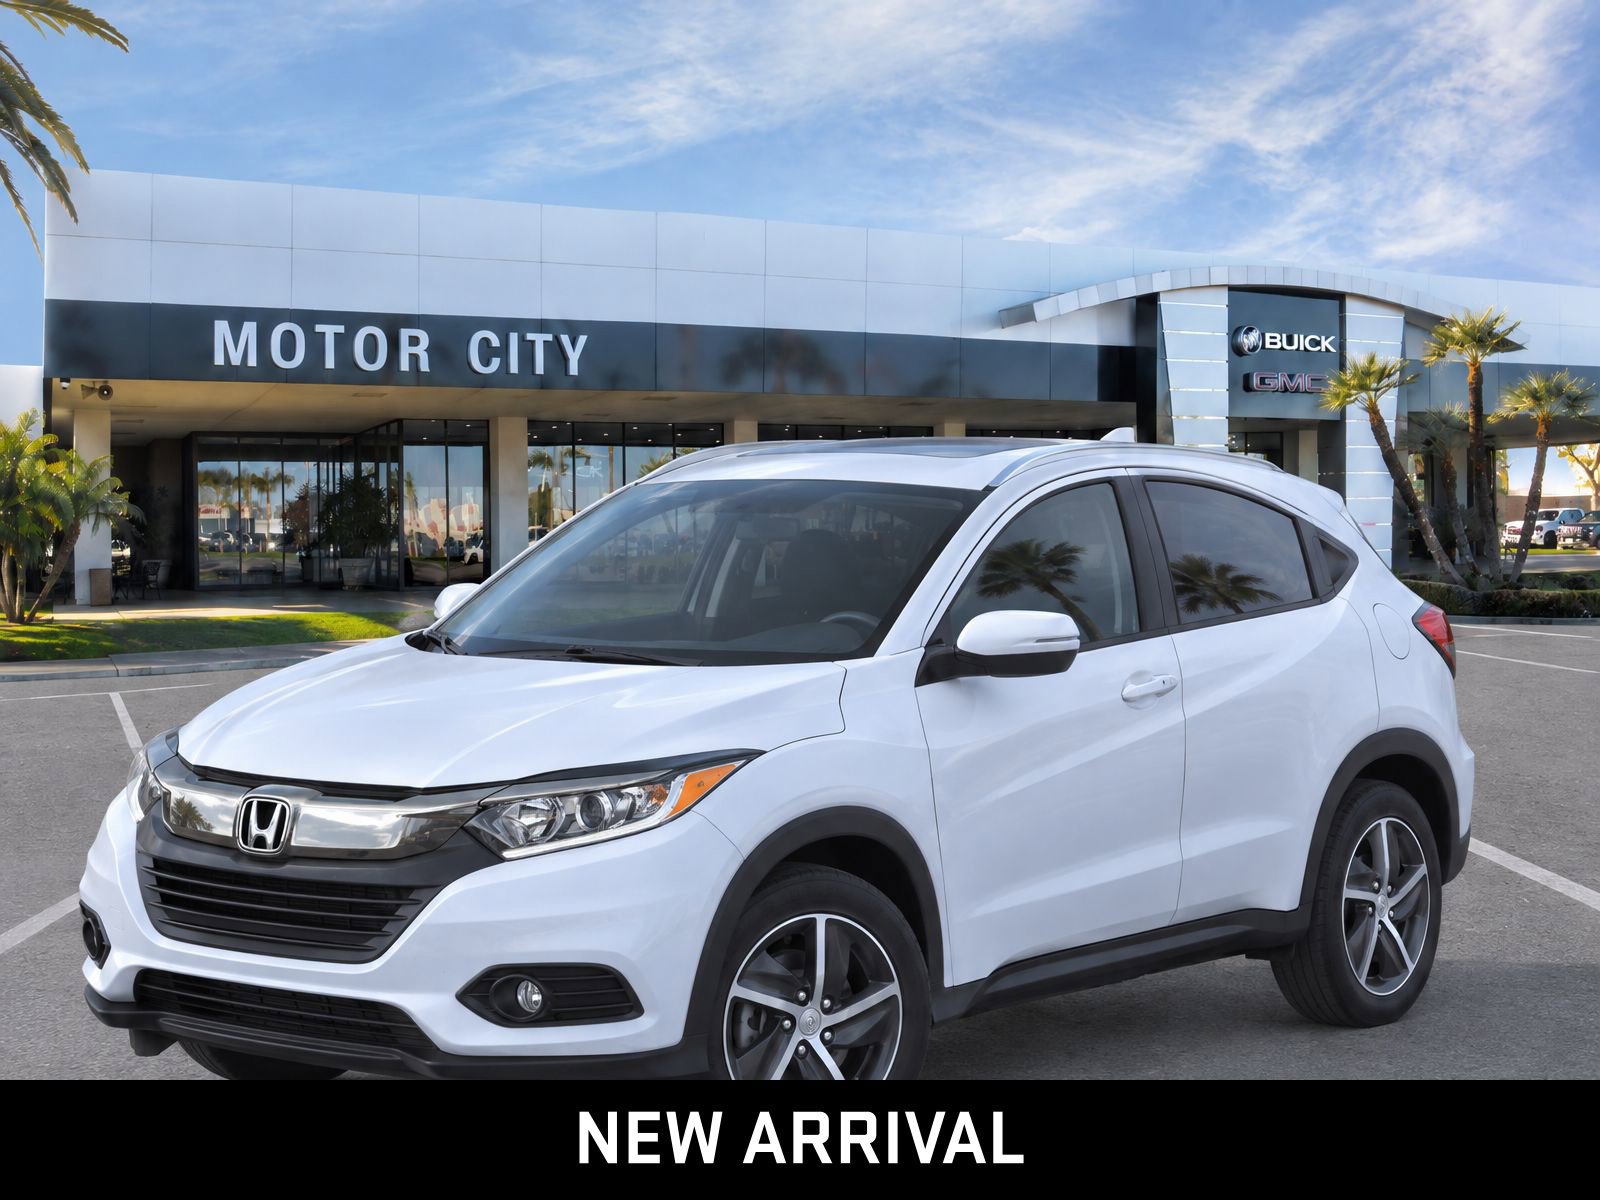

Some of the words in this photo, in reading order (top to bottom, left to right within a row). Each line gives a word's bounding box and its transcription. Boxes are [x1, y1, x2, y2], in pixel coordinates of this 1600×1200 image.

[213, 319, 431, 373] MOTOR
[468, 329, 588, 376] CITY
[1264, 332, 1337, 353] BUICK
[1253, 371, 1330, 393] GMC
